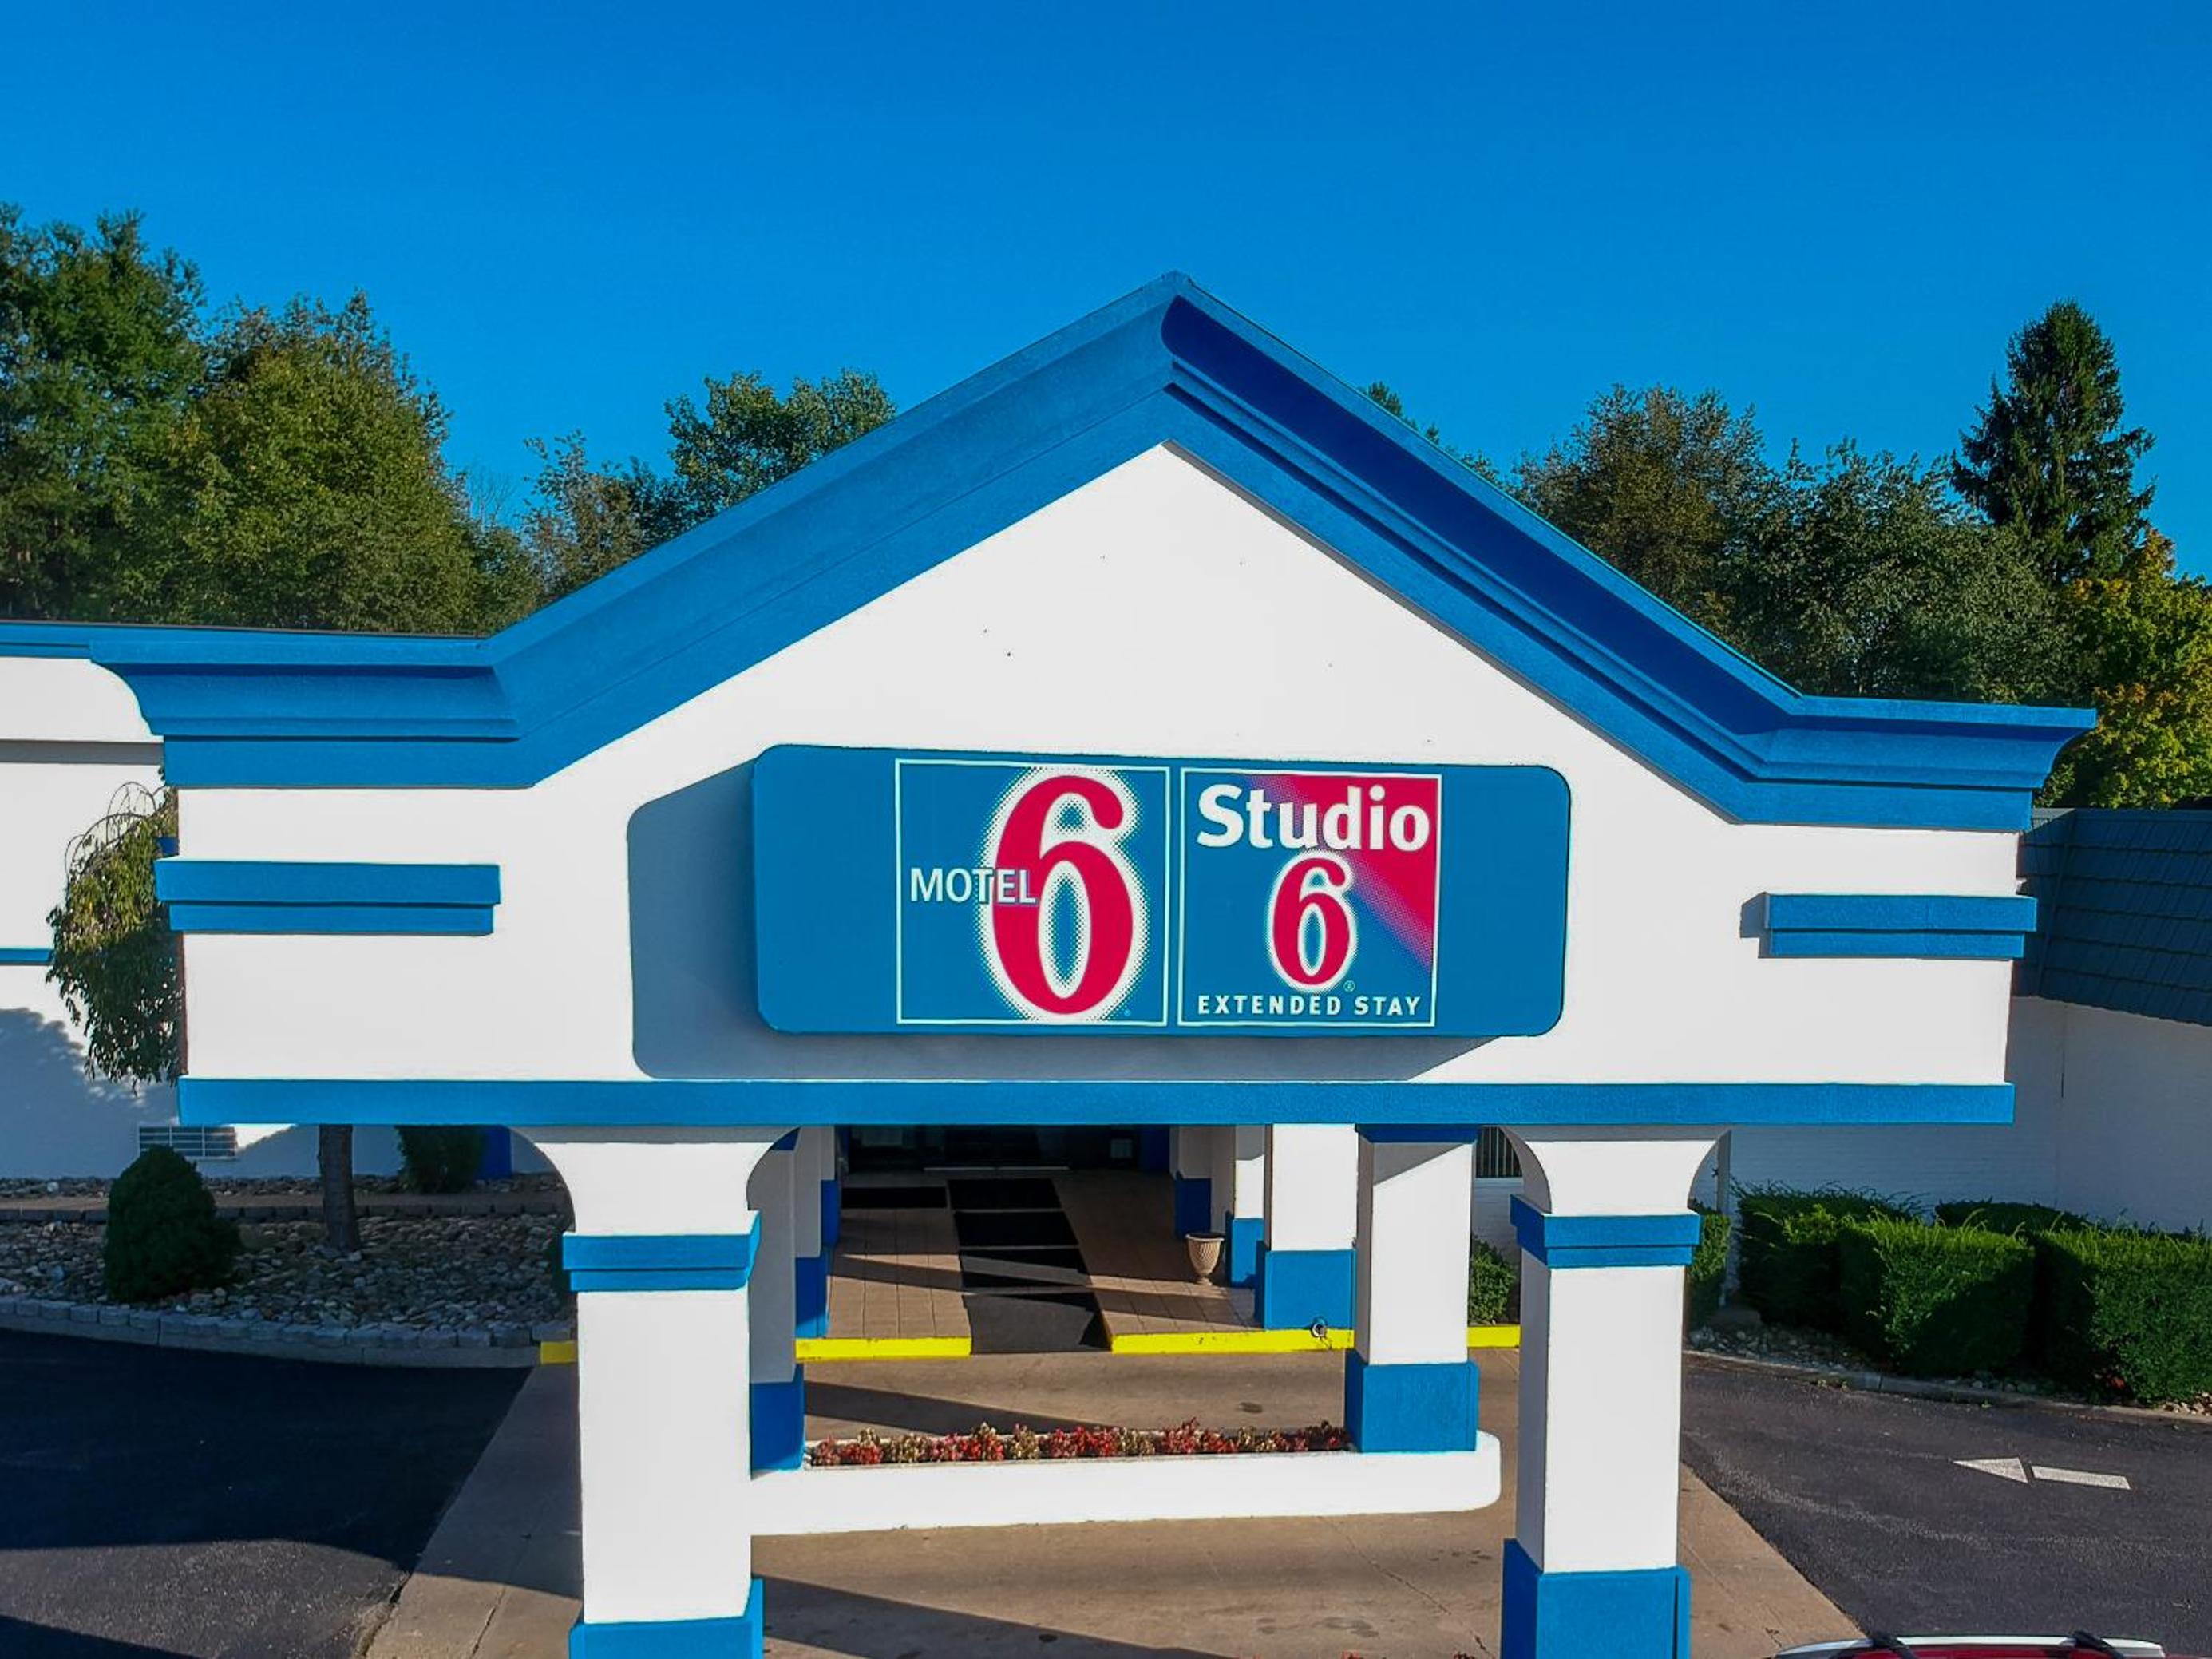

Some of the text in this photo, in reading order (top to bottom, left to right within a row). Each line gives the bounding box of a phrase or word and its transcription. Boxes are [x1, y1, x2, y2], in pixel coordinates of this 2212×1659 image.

[1196, 783, 1430, 852] Studio
[910, 774, 1134, 1015] MOTEL 6
[1272, 857, 1351, 985] 6
[1197, 995, 1421, 1016] EXTENDED STAY
